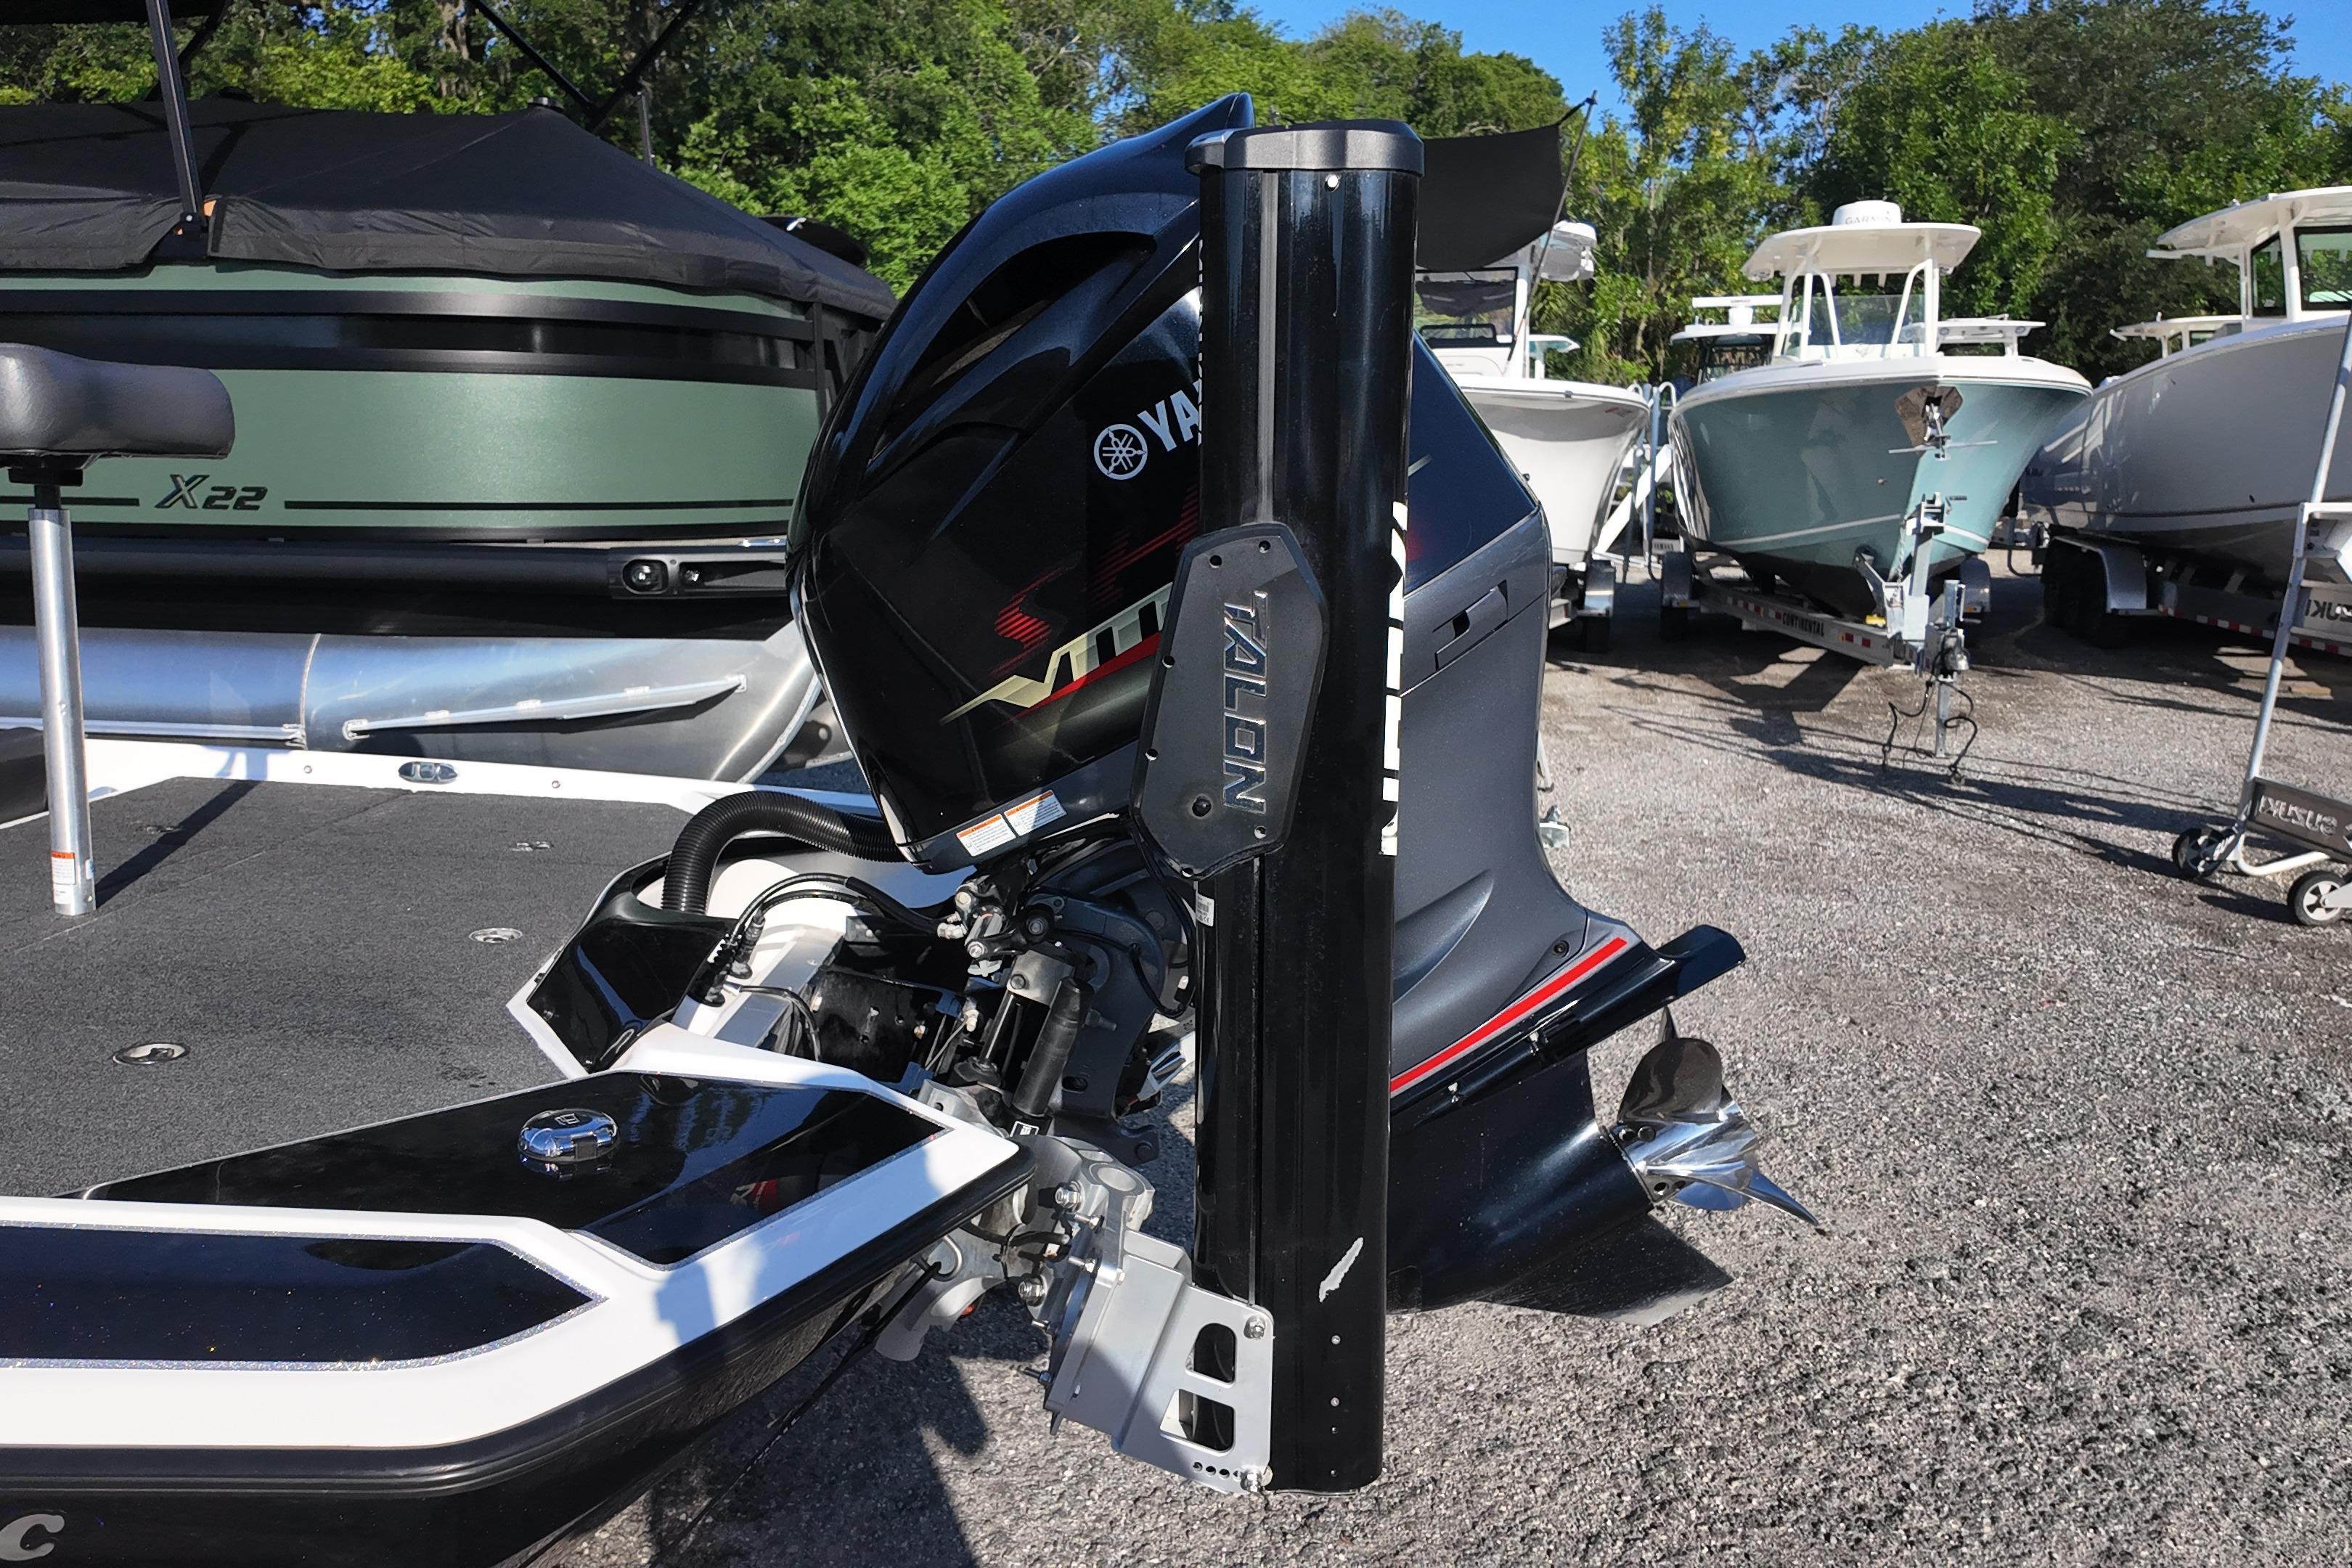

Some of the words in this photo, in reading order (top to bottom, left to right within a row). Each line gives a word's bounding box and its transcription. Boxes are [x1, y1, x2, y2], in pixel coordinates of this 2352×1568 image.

[1137, 380, 1201, 452] YA
[155, 473, 269, 510] X22
[1223, 589, 1269, 814] TALON
